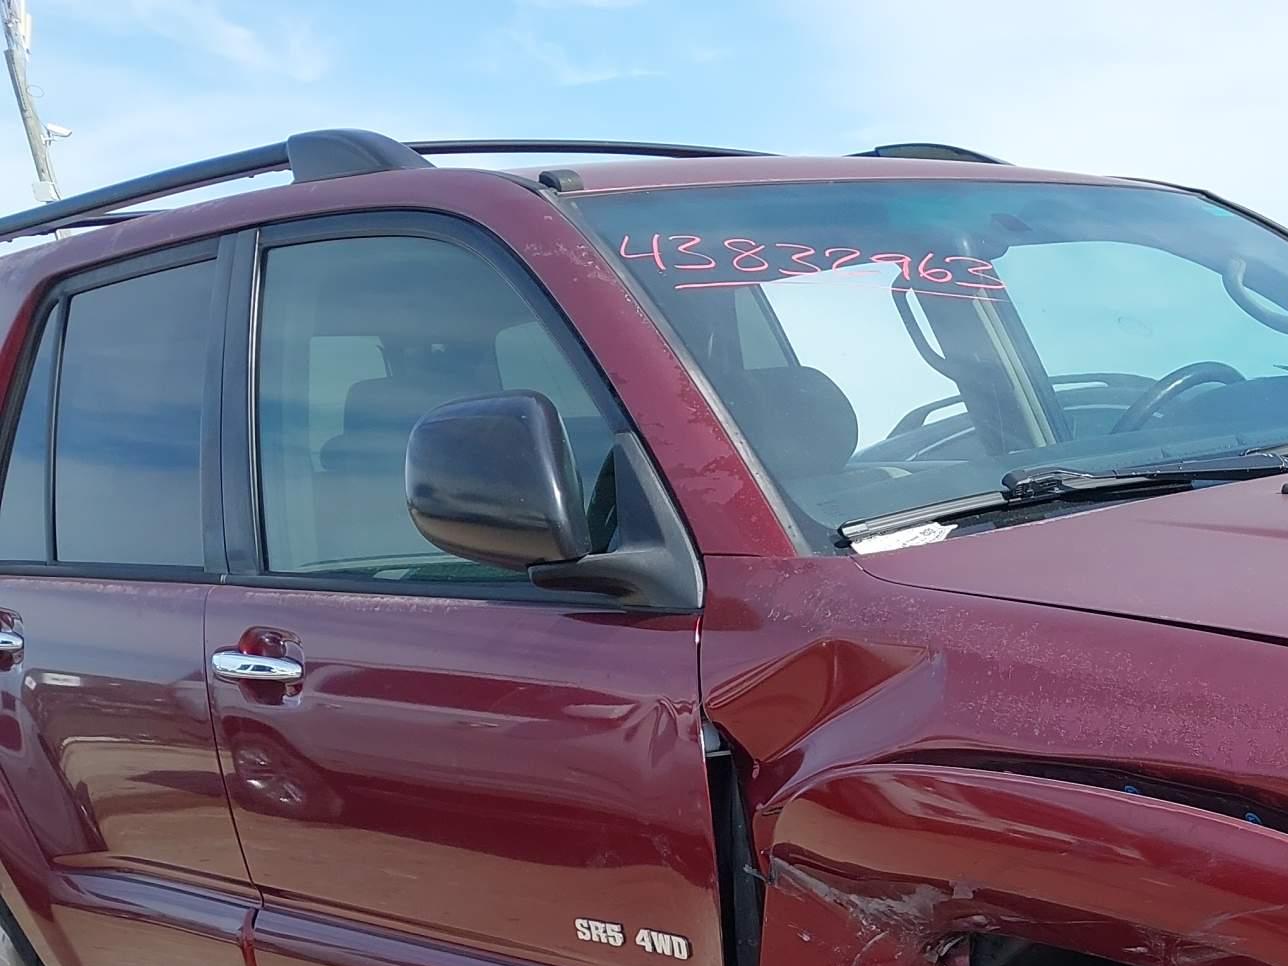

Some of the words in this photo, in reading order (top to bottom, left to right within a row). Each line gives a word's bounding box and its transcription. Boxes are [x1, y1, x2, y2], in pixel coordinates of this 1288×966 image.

[620, 233, 1007, 290] 43832963
[574, 918, 624, 947] SR5
[635, 928, 690, 960] 4WD
